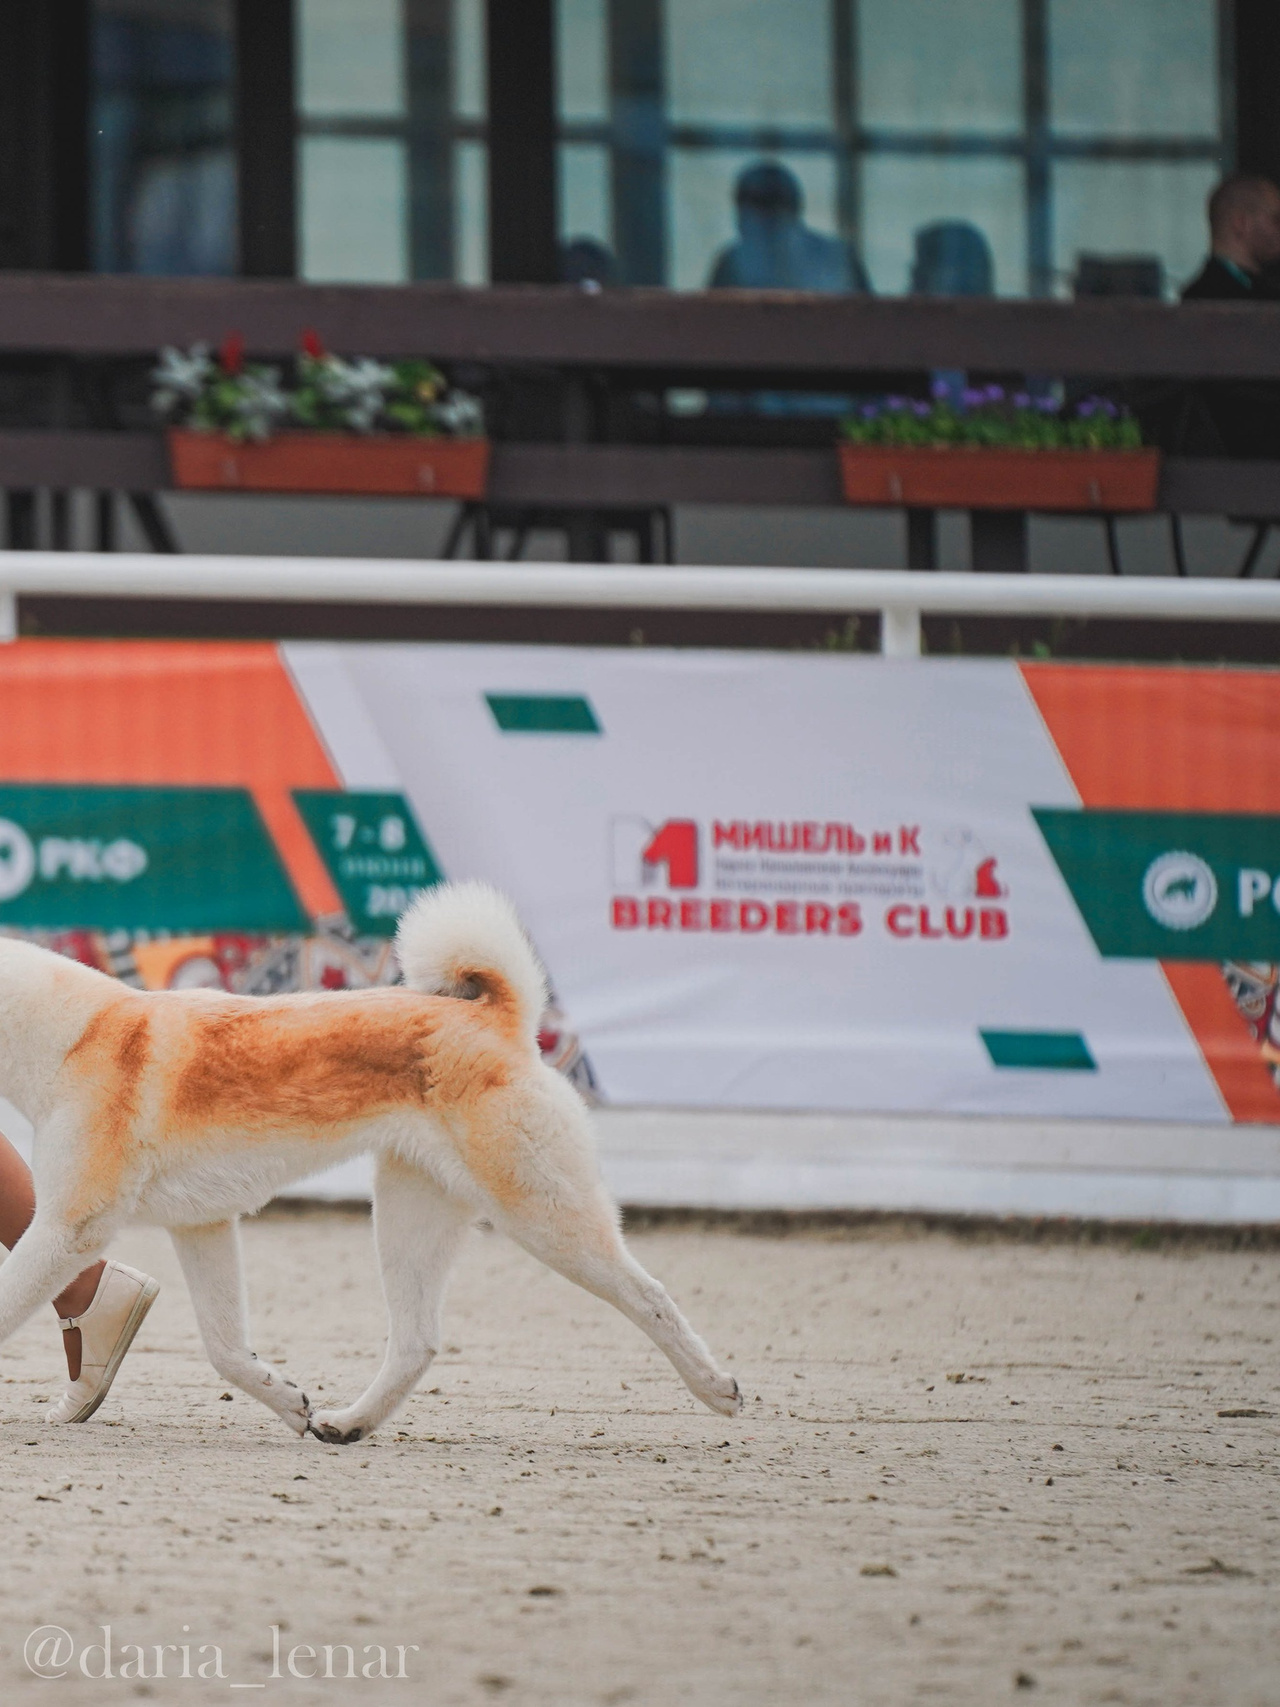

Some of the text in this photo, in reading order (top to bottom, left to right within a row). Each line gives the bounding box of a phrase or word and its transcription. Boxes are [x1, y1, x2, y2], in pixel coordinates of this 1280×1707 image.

[39, 837, 148, 882] РКФ
[899, 825, 921, 857] К
[1237, 867, 1280, 919] Р
[611, 897, 1011, 940] BREEDERS CLUB
